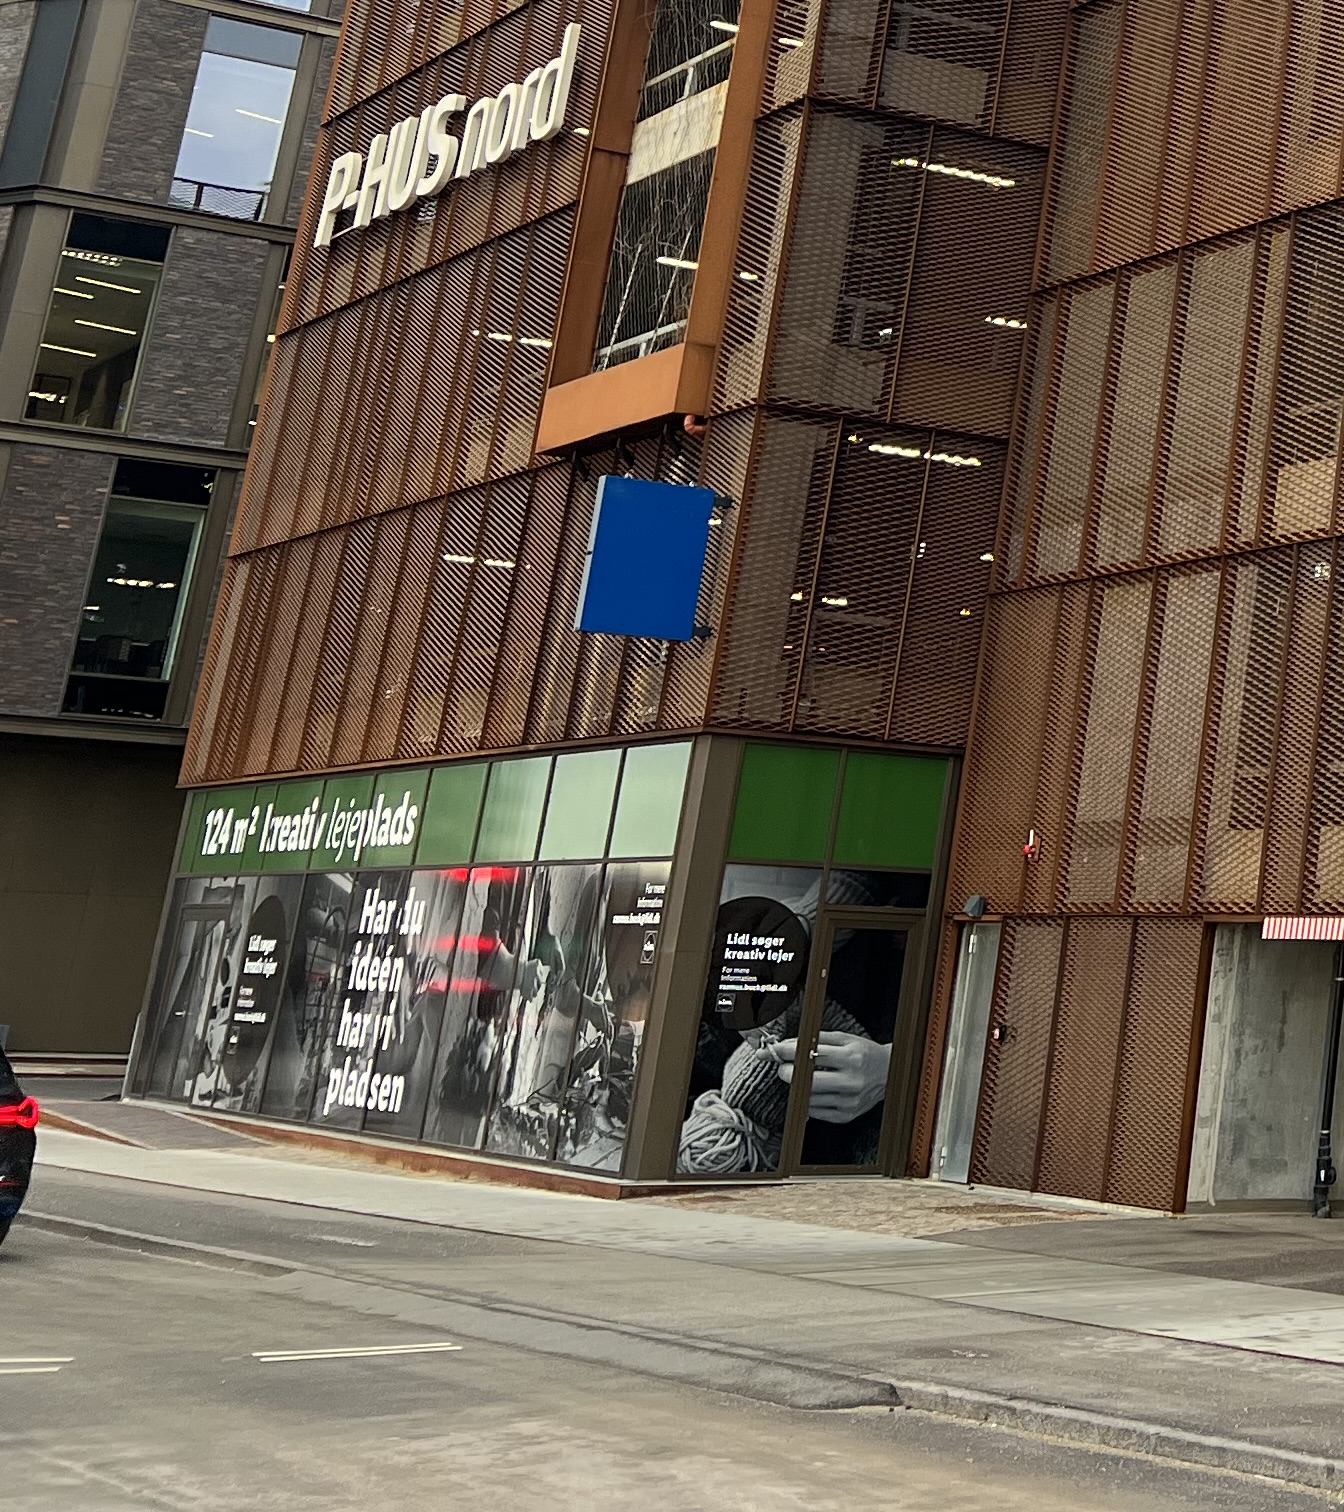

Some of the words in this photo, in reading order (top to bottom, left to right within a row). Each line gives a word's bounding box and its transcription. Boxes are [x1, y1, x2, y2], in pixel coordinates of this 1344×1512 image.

[314, 93, 466, 248] P-HUS
[455, 22, 582, 178] nord
[201, 807, 235, 856] 124
[258, 796, 328, 853] kreativ
[325, 790, 419, 863] lejeplads
[358, 887, 397, 935] Har
[395, 887, 427, 936] du
[347, 940, 405, 992] ideén
[724, 947, 766, 960] kreativ
[766, 949, 795, 964] lejer
[726, 933, 750, 946] Lidl
[751, 936, 785, 949] søger
[336, 998, 372, 1049] har
[371, 999, 398, 1051] vi
[322, 1055, 406, 1116] pladsen
